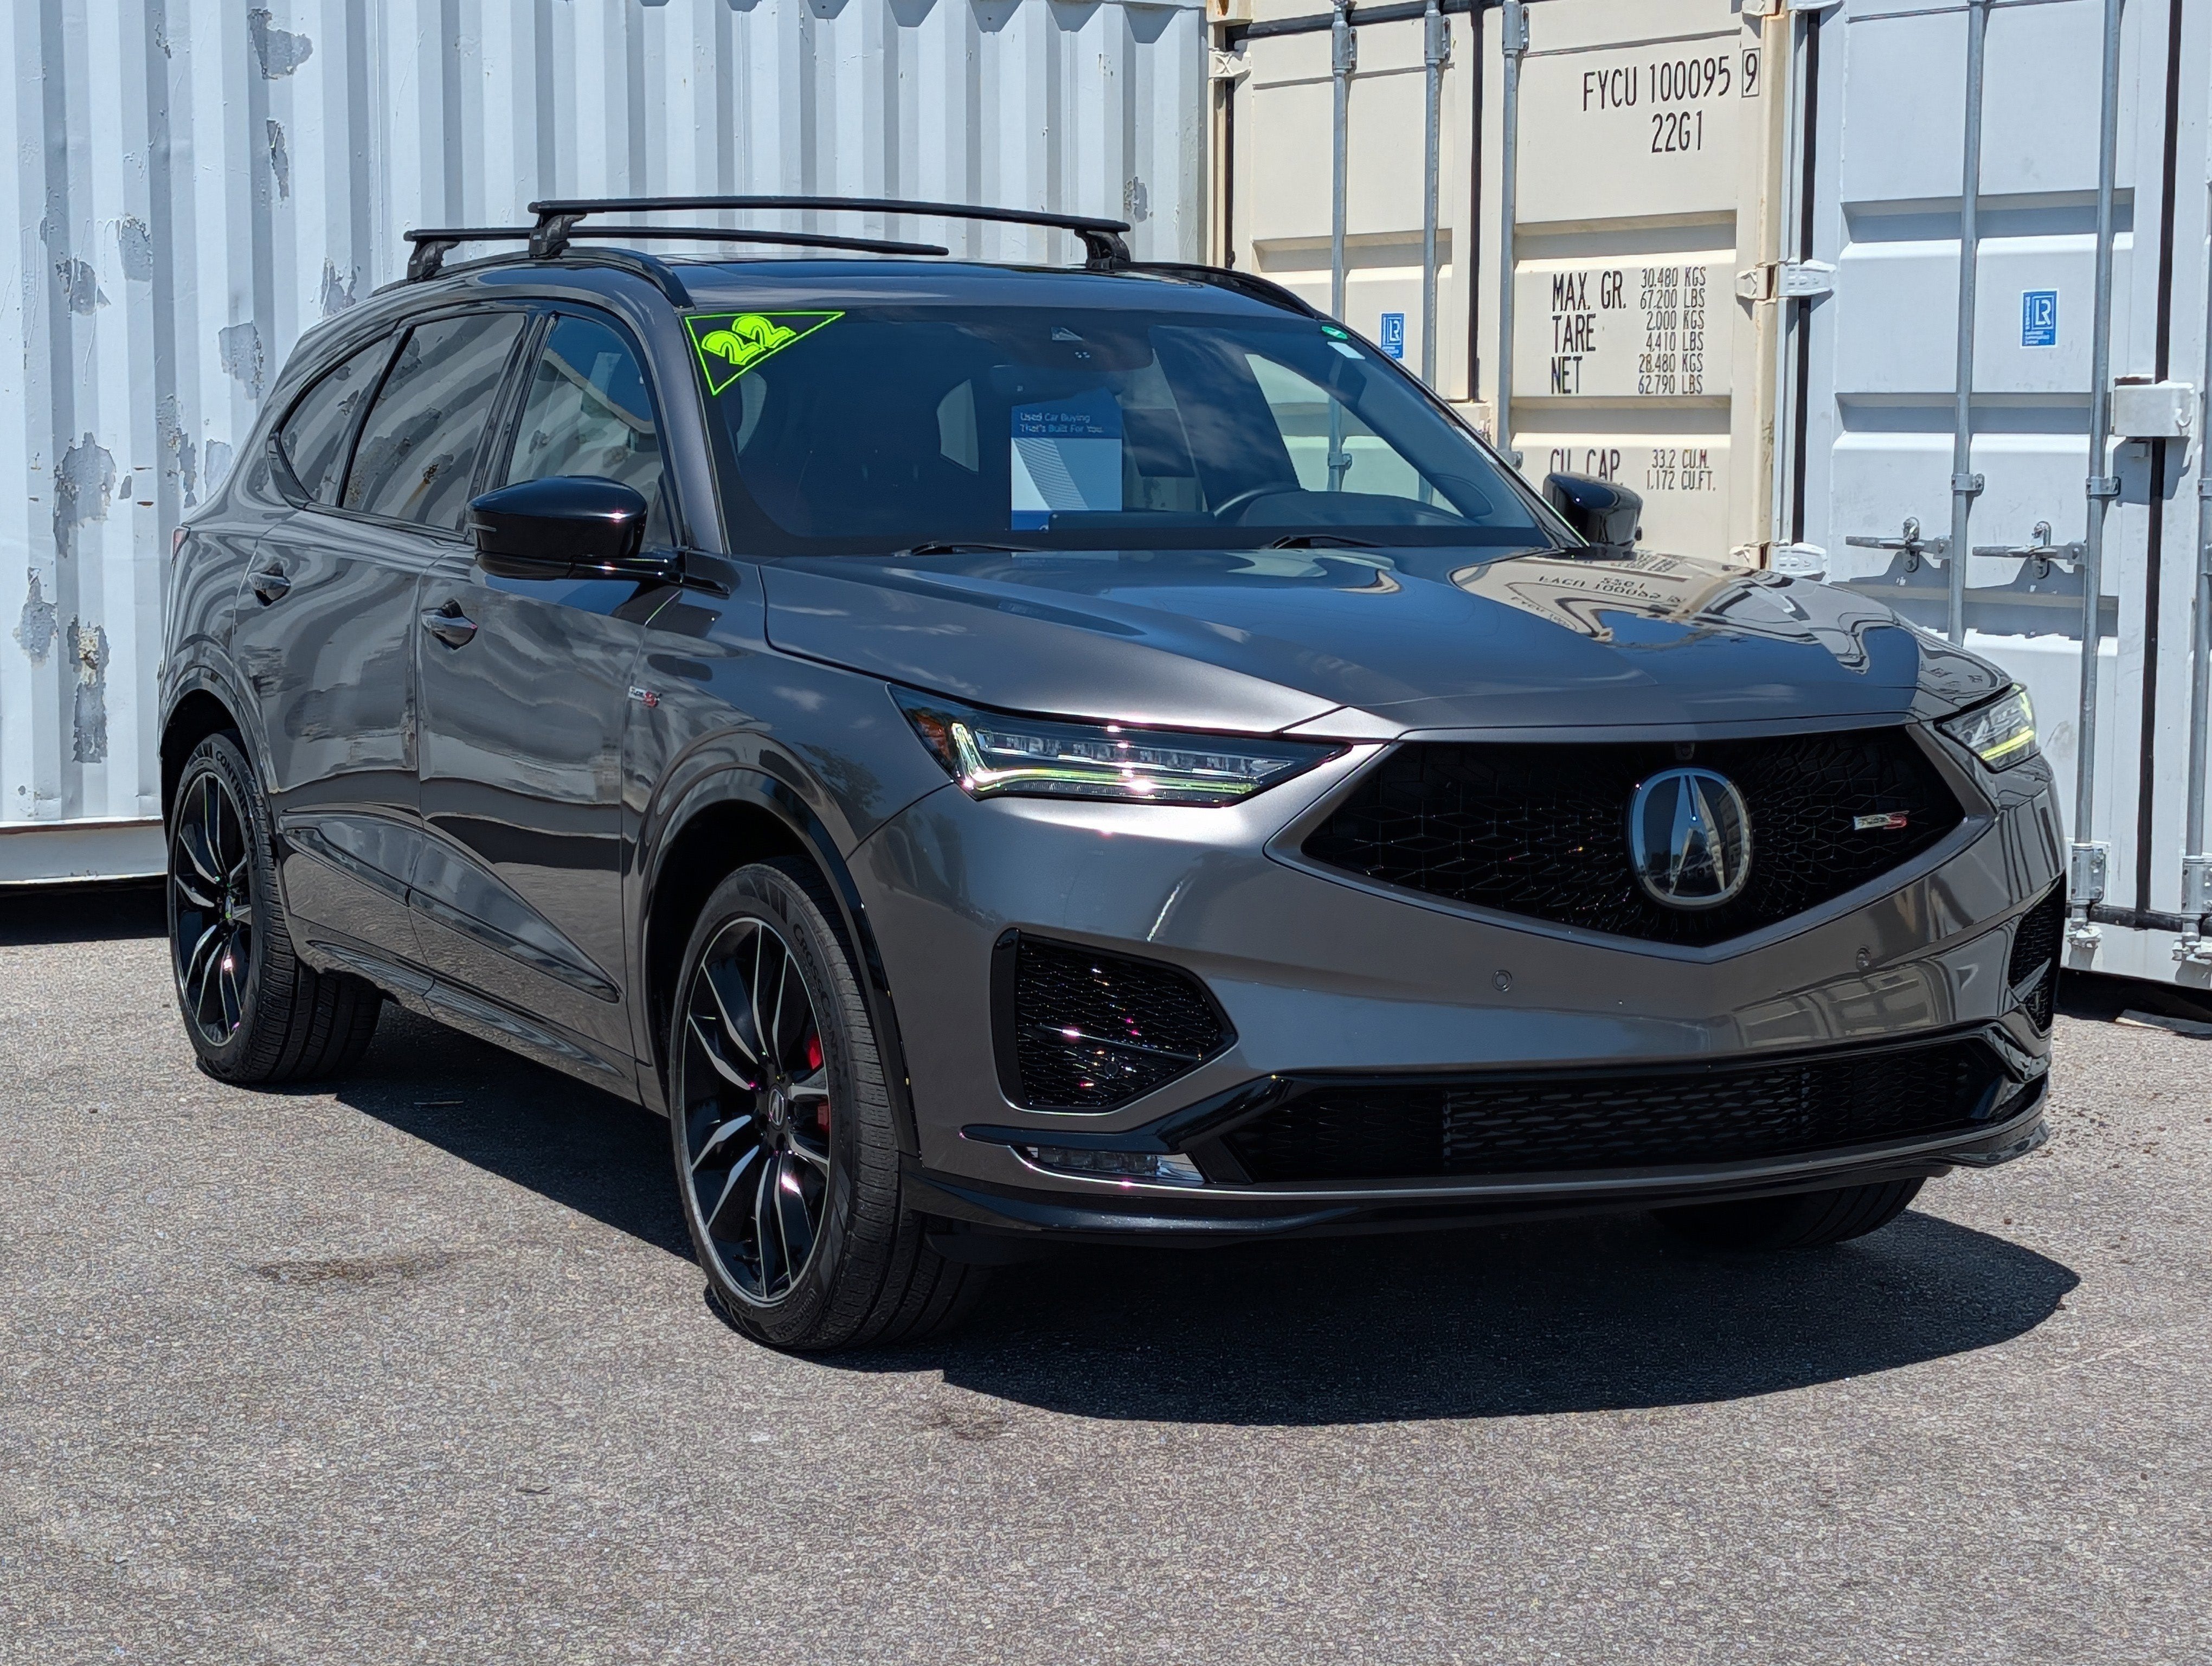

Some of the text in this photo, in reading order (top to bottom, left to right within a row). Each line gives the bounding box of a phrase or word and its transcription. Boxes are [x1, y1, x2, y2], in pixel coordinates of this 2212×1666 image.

[1583, 53, 1758, 112] FYCU 100095 9
[1651, 110, 1703, 153] 22G1
[1552, 272, 1591, 312] MAX.
[1601, 270, 1626, 309] GR.
[1684, 266, 1706, 287] KGS
[1683, 288, 1705, 309] LBS
[702, 315, 797, 366] 22
[1552, 313, 1597, 353] TARE
[1683, 310, 1705, 330] KGS
[1682, 331, 1704, 351] LBS
[1551, 356, 1583, 395] NET
[1682, 353, 1703, 373] KGS
[1681, 374, 1703, 395] LBS
[1020, 412, 1043, 421] Used
[1044, 413, 1058, 421] Car
[1070, 424, 1084, 432] For
